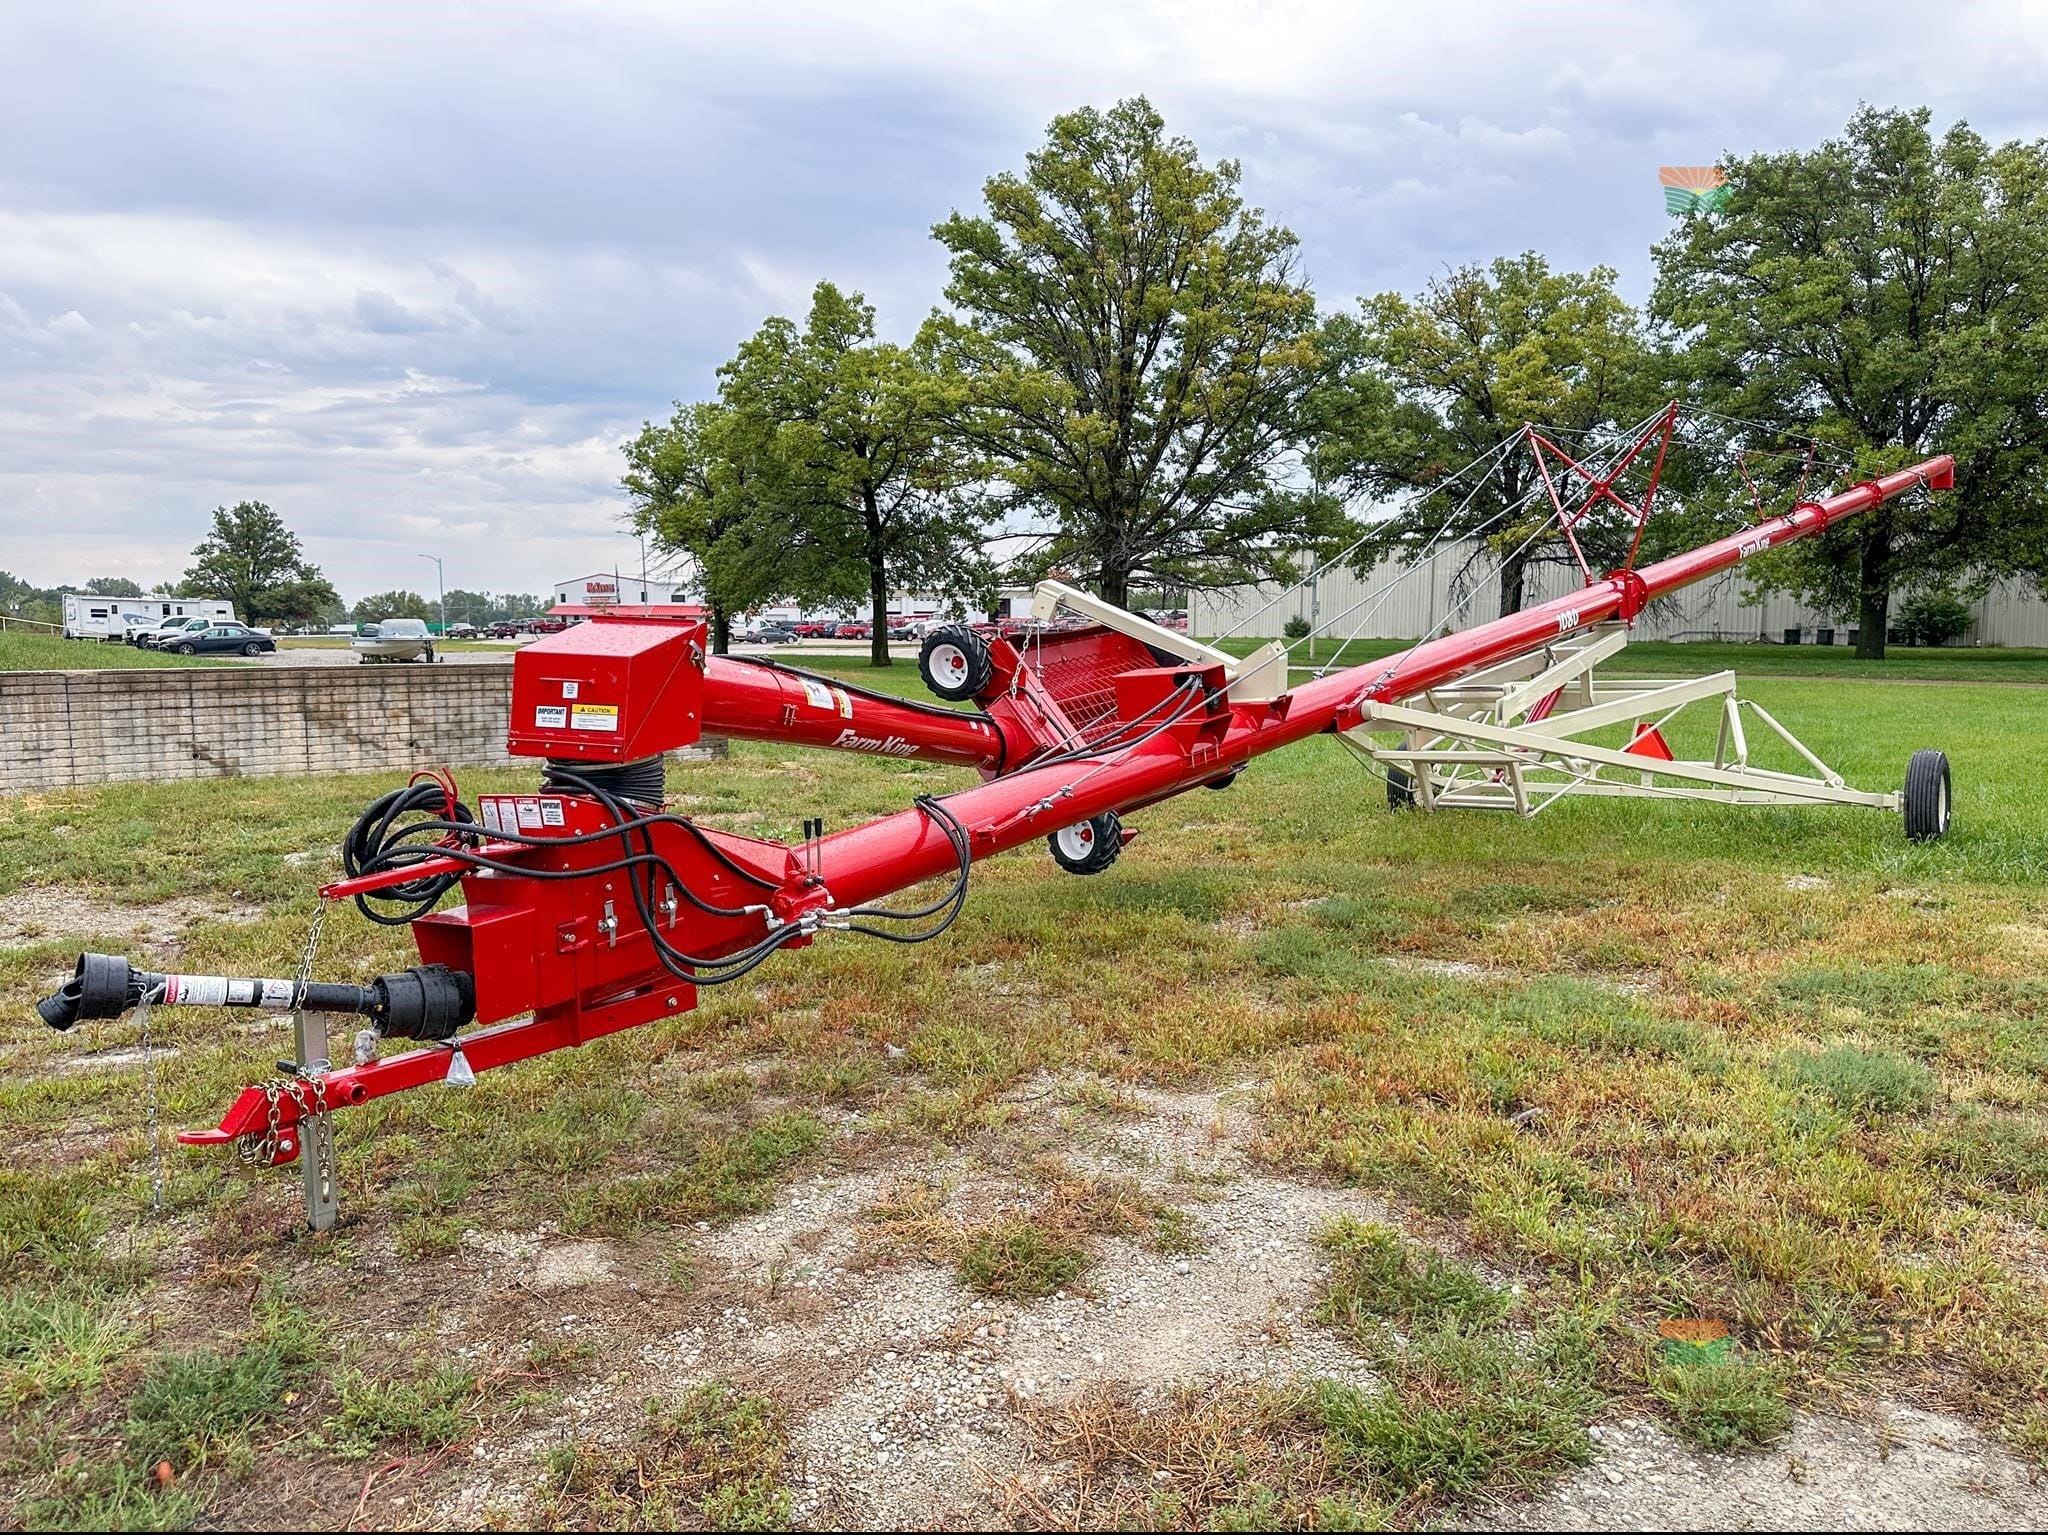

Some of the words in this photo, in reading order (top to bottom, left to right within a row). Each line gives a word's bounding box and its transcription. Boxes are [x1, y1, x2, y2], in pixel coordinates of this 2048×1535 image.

[1738, 542, 1756, 559] Farm
[1755, 536, 1770, 553] King
[1556, 608, 1579, 632] 1080
[831, 728, 882, 751] Farm
[877, 735, 921, 757] King
